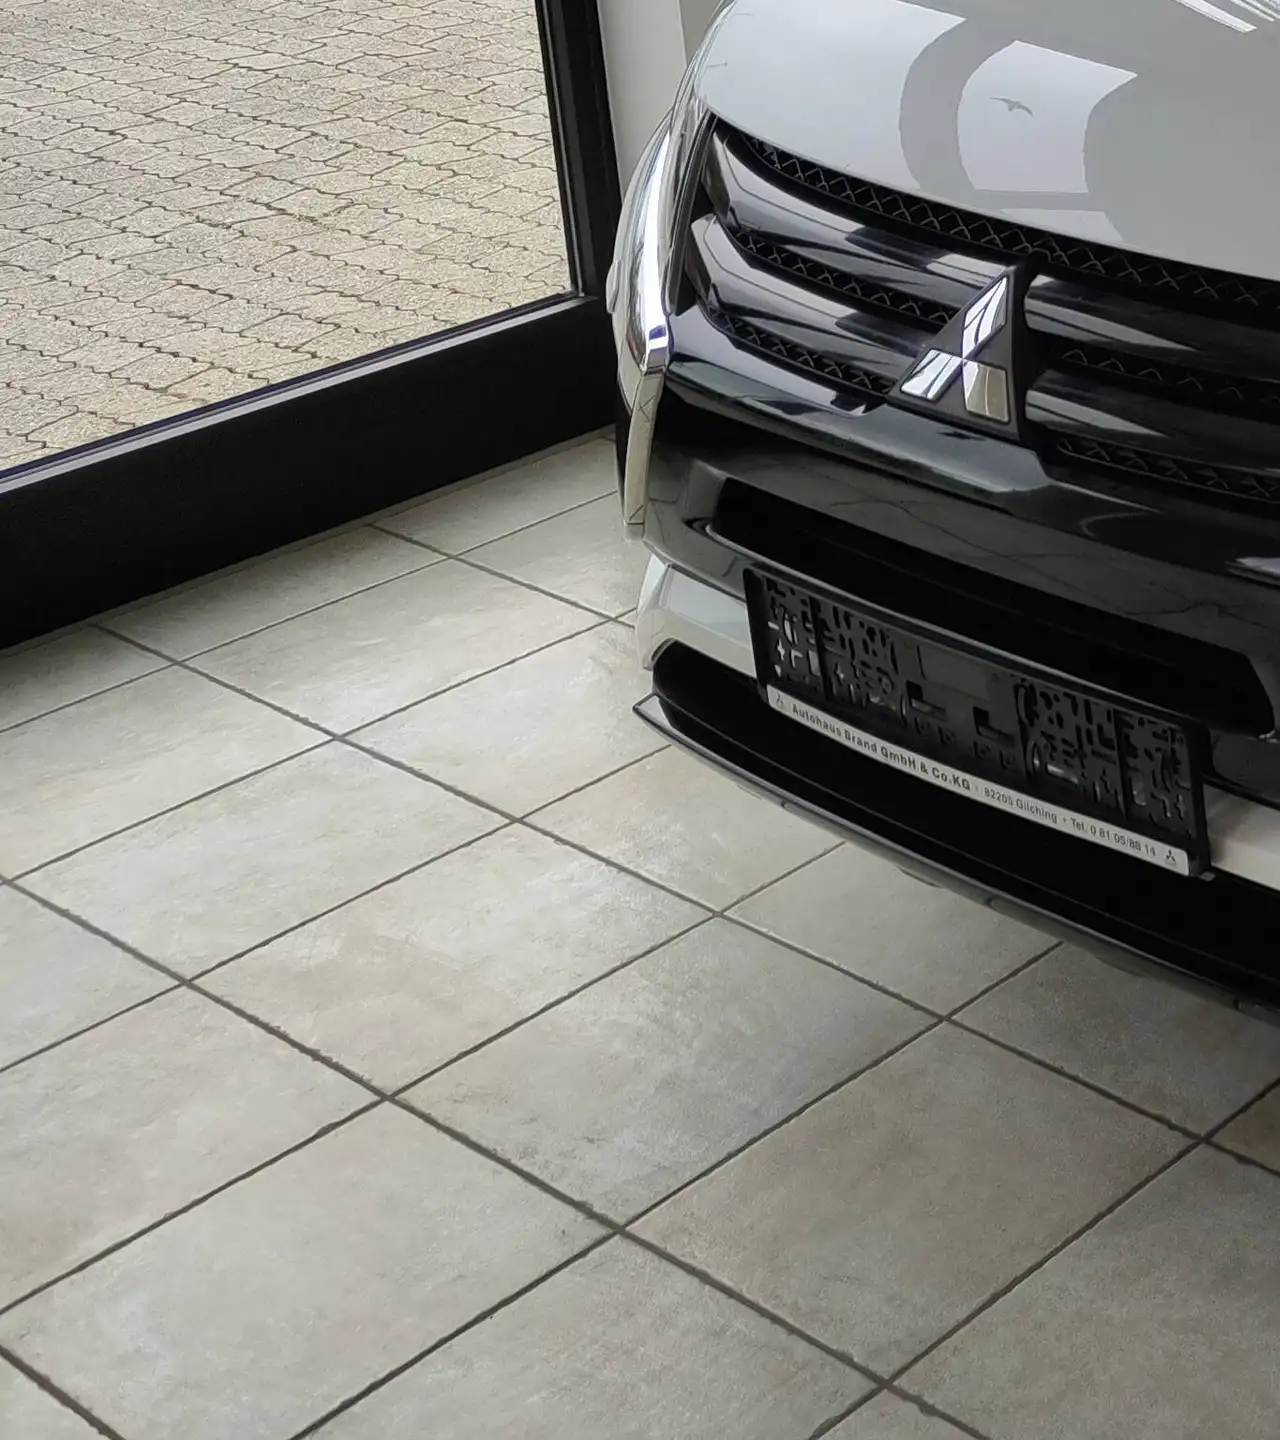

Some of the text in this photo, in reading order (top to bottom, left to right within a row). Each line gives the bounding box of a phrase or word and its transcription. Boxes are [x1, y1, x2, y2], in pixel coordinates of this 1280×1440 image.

[792, 703, 843, 738] Autohaus
[844, 728, 878, 753] Brand
[880, 746, 917, 770] GmbH
[920, 761, 929, 775] &
[984, 787, 1013, 806] 82205
[1015, 798, 1058, 824] Gilching
[1070, 817, 1088, 833] Tel.
[1089, 825, 1097, 836] 0
[1099, 828, 1111, 841] 81
[1145, 844, 1156, 857] 14
